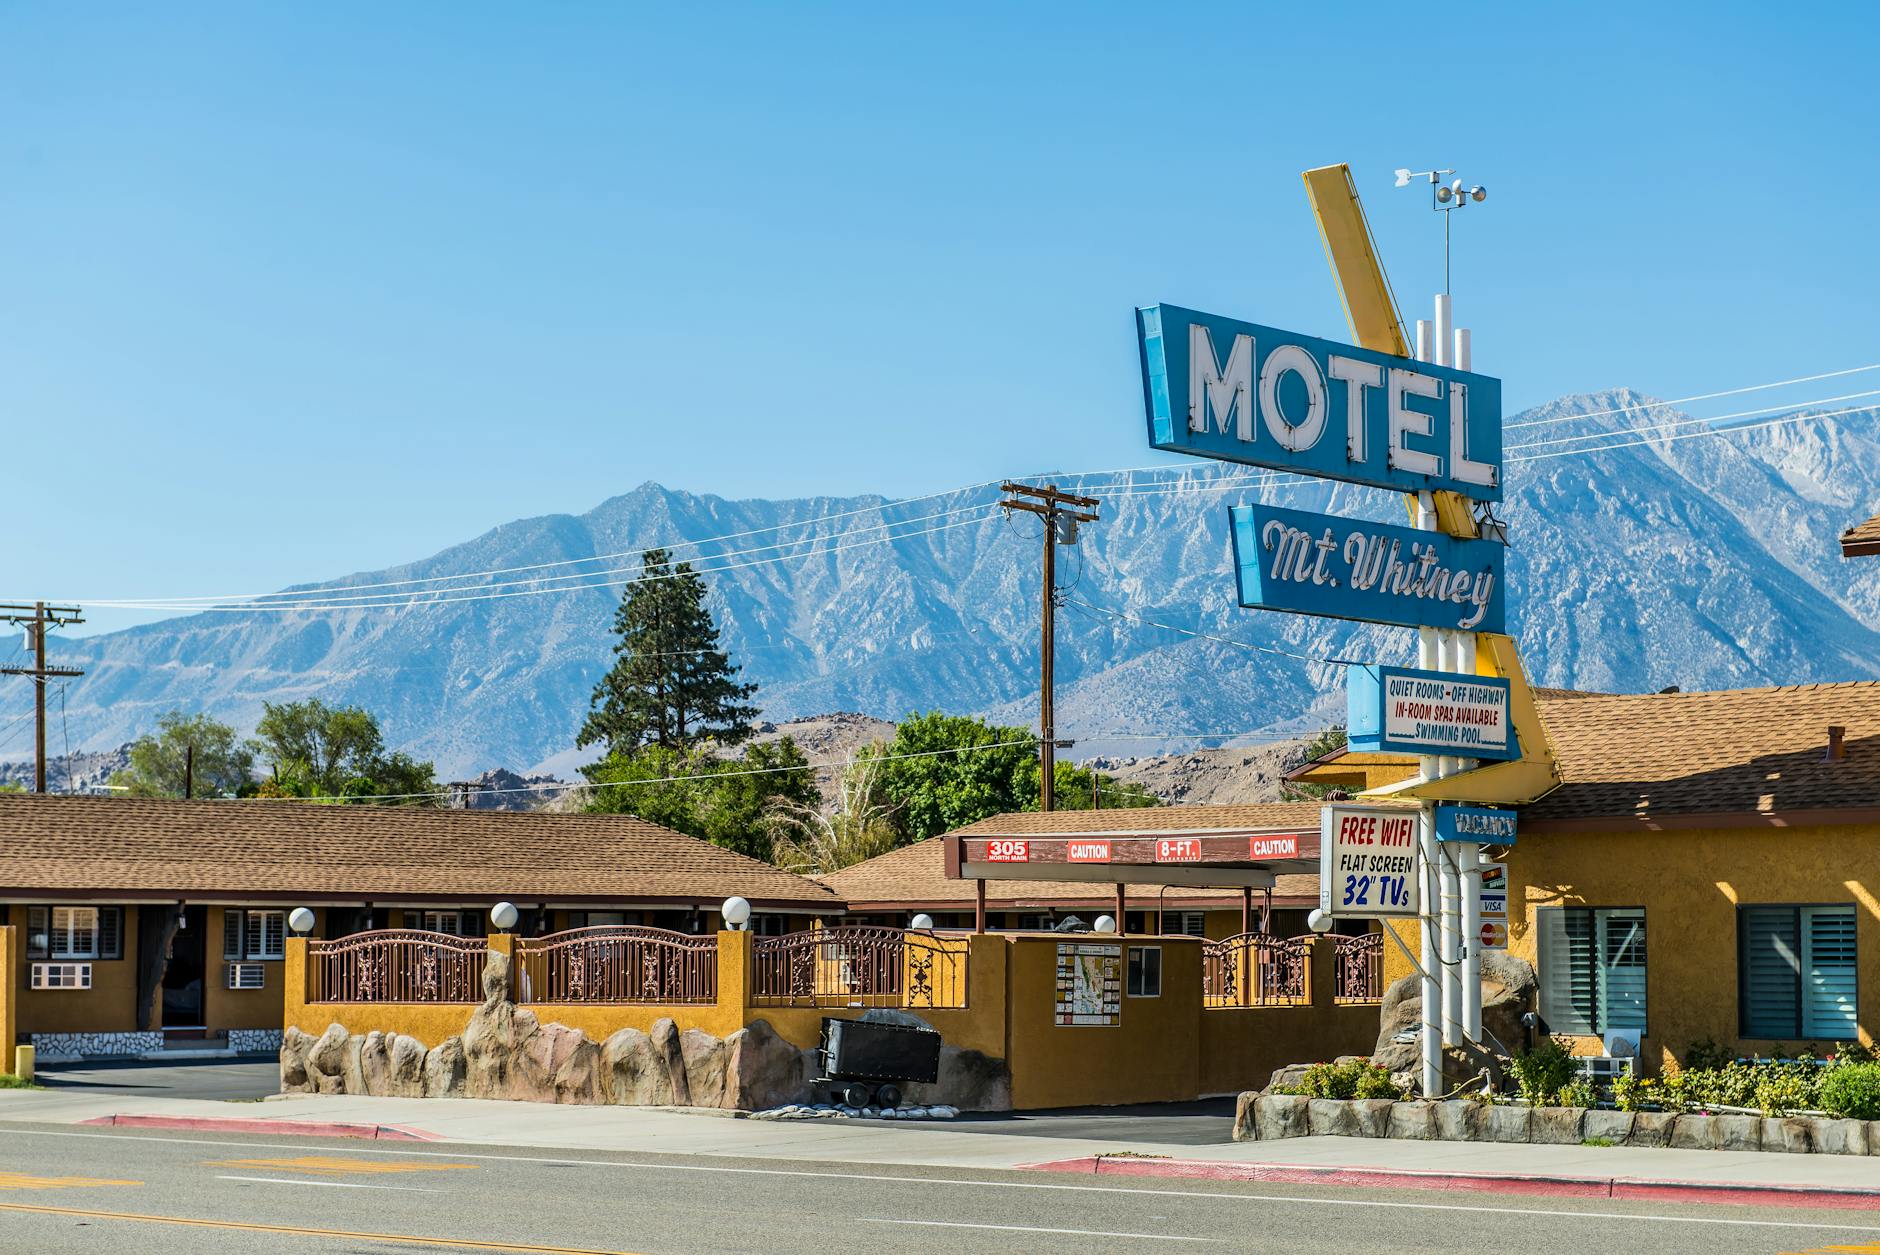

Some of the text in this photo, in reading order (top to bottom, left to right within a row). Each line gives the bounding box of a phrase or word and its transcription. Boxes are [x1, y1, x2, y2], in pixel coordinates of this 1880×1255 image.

[1188, 323, 1500, 488] MOTEL
[1262, 519, 1495, 628] Mt. Whitney
[1389, 680, 1414, 697] QUIET
[1416, 682, 1445, 700] ROOMS
[1451, 686, 1467, 702] OFF
[1468, 686, 1505, 706] HIGHWAY
[1395, 701, 1498, 726] IN-ROOM SPAS AVAILABLE
[1415, 722, 1481, 744] SWIMMING POOL
[1339, 817, 1413, 847] FREE WIFI
[1454, 813, 1515, 836] VACANCY
[990, 841, 1026, 855] 305
[1071, 844, 1108, 858] CAUTION
[1161, 841, 1196, 857] 8-FT.
[1253, 839, 1295, 856] CAUTION
[1340, 854, 1413, 873] FLAT SCREEN
[1343, 874, 1409, 906] 32" TVs
[1484, 901, 1502, 911] VISA
